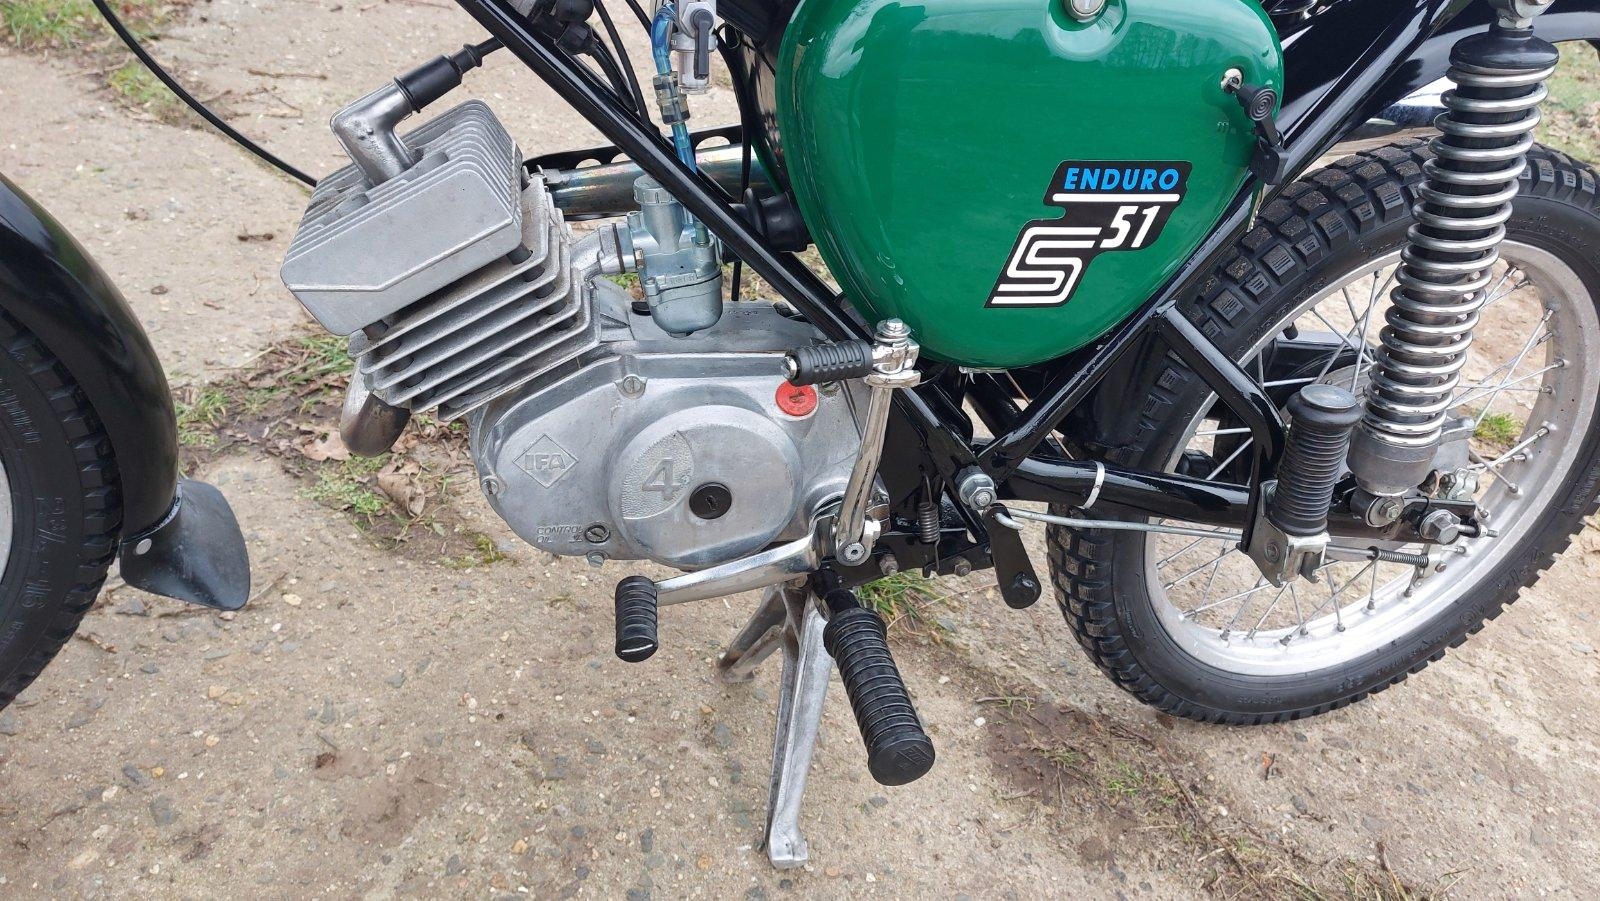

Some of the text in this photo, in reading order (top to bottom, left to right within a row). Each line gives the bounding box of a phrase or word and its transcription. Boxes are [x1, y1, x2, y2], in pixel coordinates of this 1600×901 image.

[1064, 168, 1179, 190] ENDURO
[525, 454, 566, 470] IFA
[642, 457, 682, 502] 4
[537, 525, 583, 534] CONTROL
[537, 535, 552, 543] OIL
